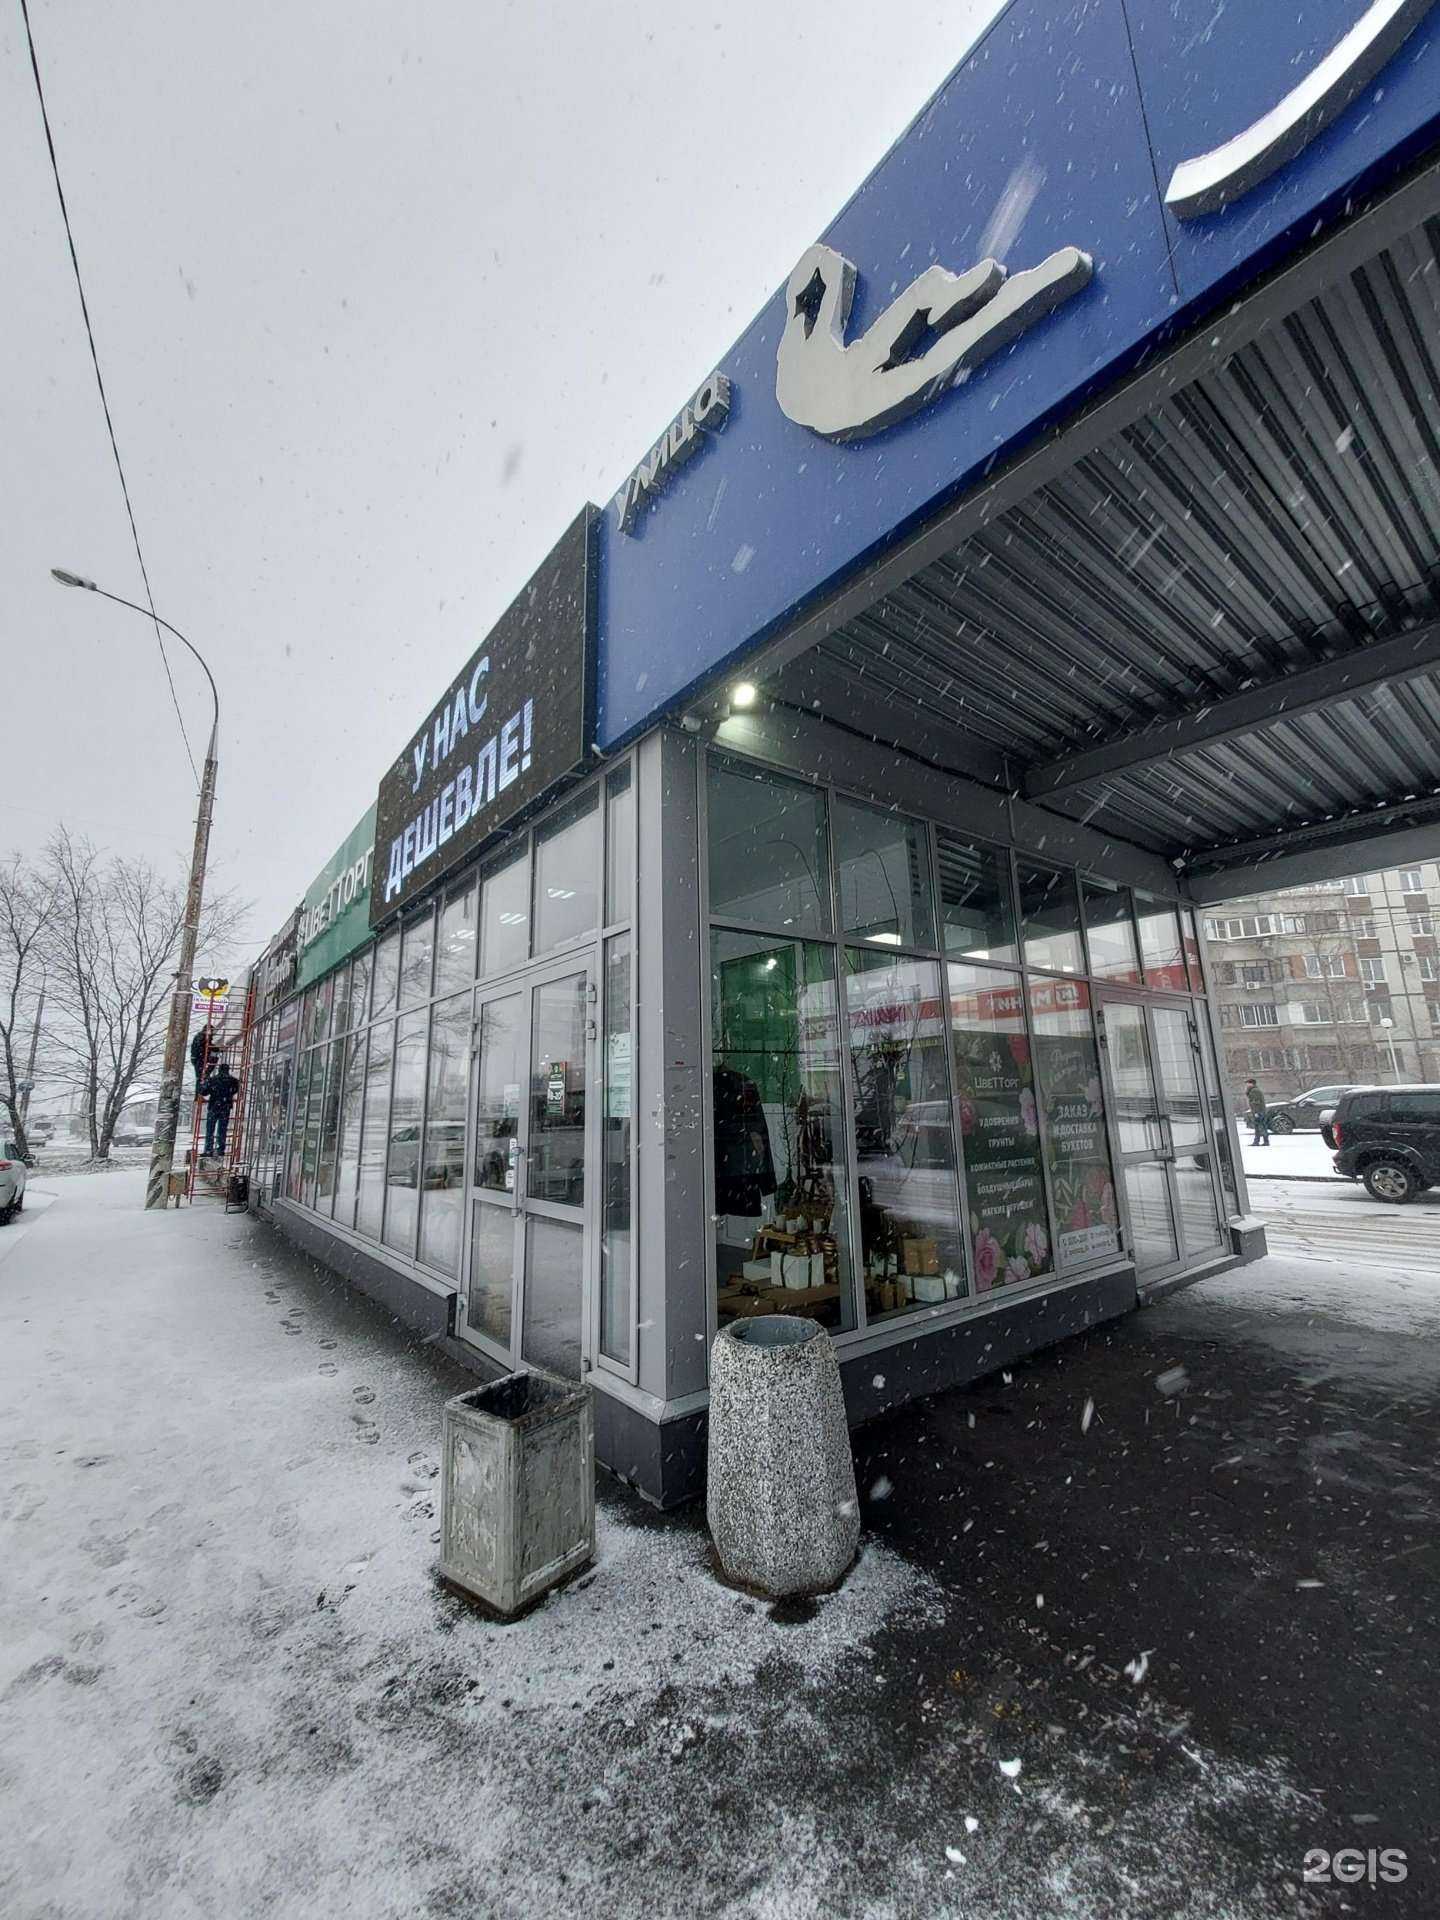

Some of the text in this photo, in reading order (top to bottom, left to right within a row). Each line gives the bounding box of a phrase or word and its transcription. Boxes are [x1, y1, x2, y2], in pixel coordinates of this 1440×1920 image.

[412, 656, 490, 793] У НАС
[385, 699, 533, 903] ДЕШЕВЛЕ!
[1057, 1104, 1089, 1119] ЗАКАЗ
[979, 1115, 1019, 1127] УДОБРЕНИЯ
[988, 1136, 1015, 1148] ГРУНТЫ
[1061, 1139, 1094, 1152] БУКЕТОВ
